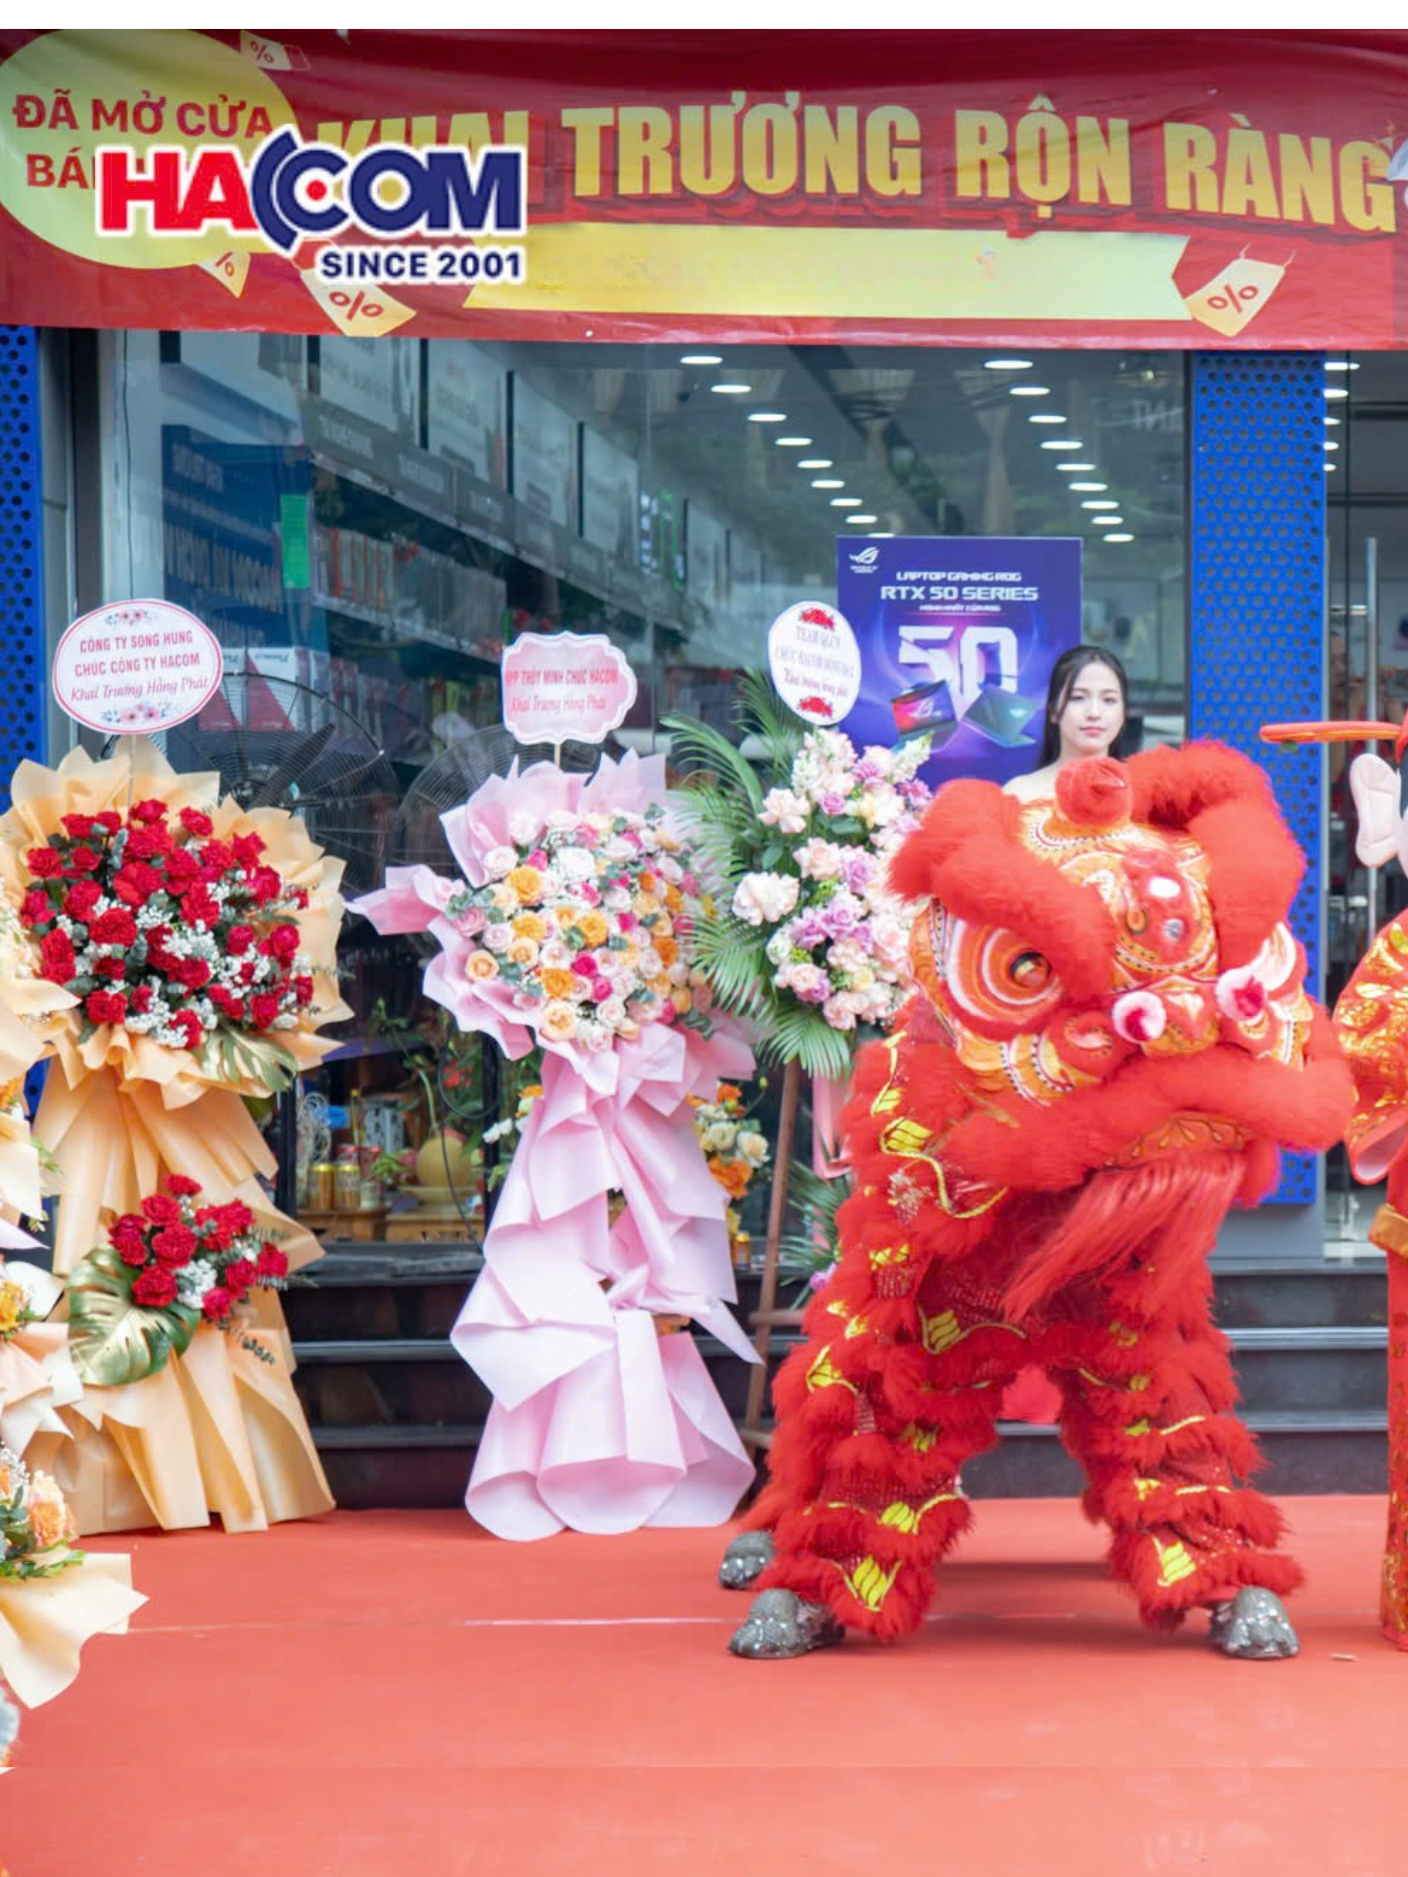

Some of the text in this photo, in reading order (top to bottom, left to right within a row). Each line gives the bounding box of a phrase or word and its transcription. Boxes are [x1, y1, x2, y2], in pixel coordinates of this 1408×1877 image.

[12, 88, 79, 130] ĐÃ
[91, 90, 167, 134] MỞ
[176, 94, 273, 138] CỬA
[561, 91, 1397, 232] TRƯƠNG RỘN RÀNG
[896, 571, 946, 582] LAPTOP
[947, 571, 993, 582] GAMING
[880, 586, 1039, 601] RTX 50 SERIES
[115, 636, 127, 651] TY
[131, 632, 160, 649] SONG
[143, 655, 157, 670] TY
[160, 652, 201, 669] HACOM
[898, 626, 1019, 707] 50
